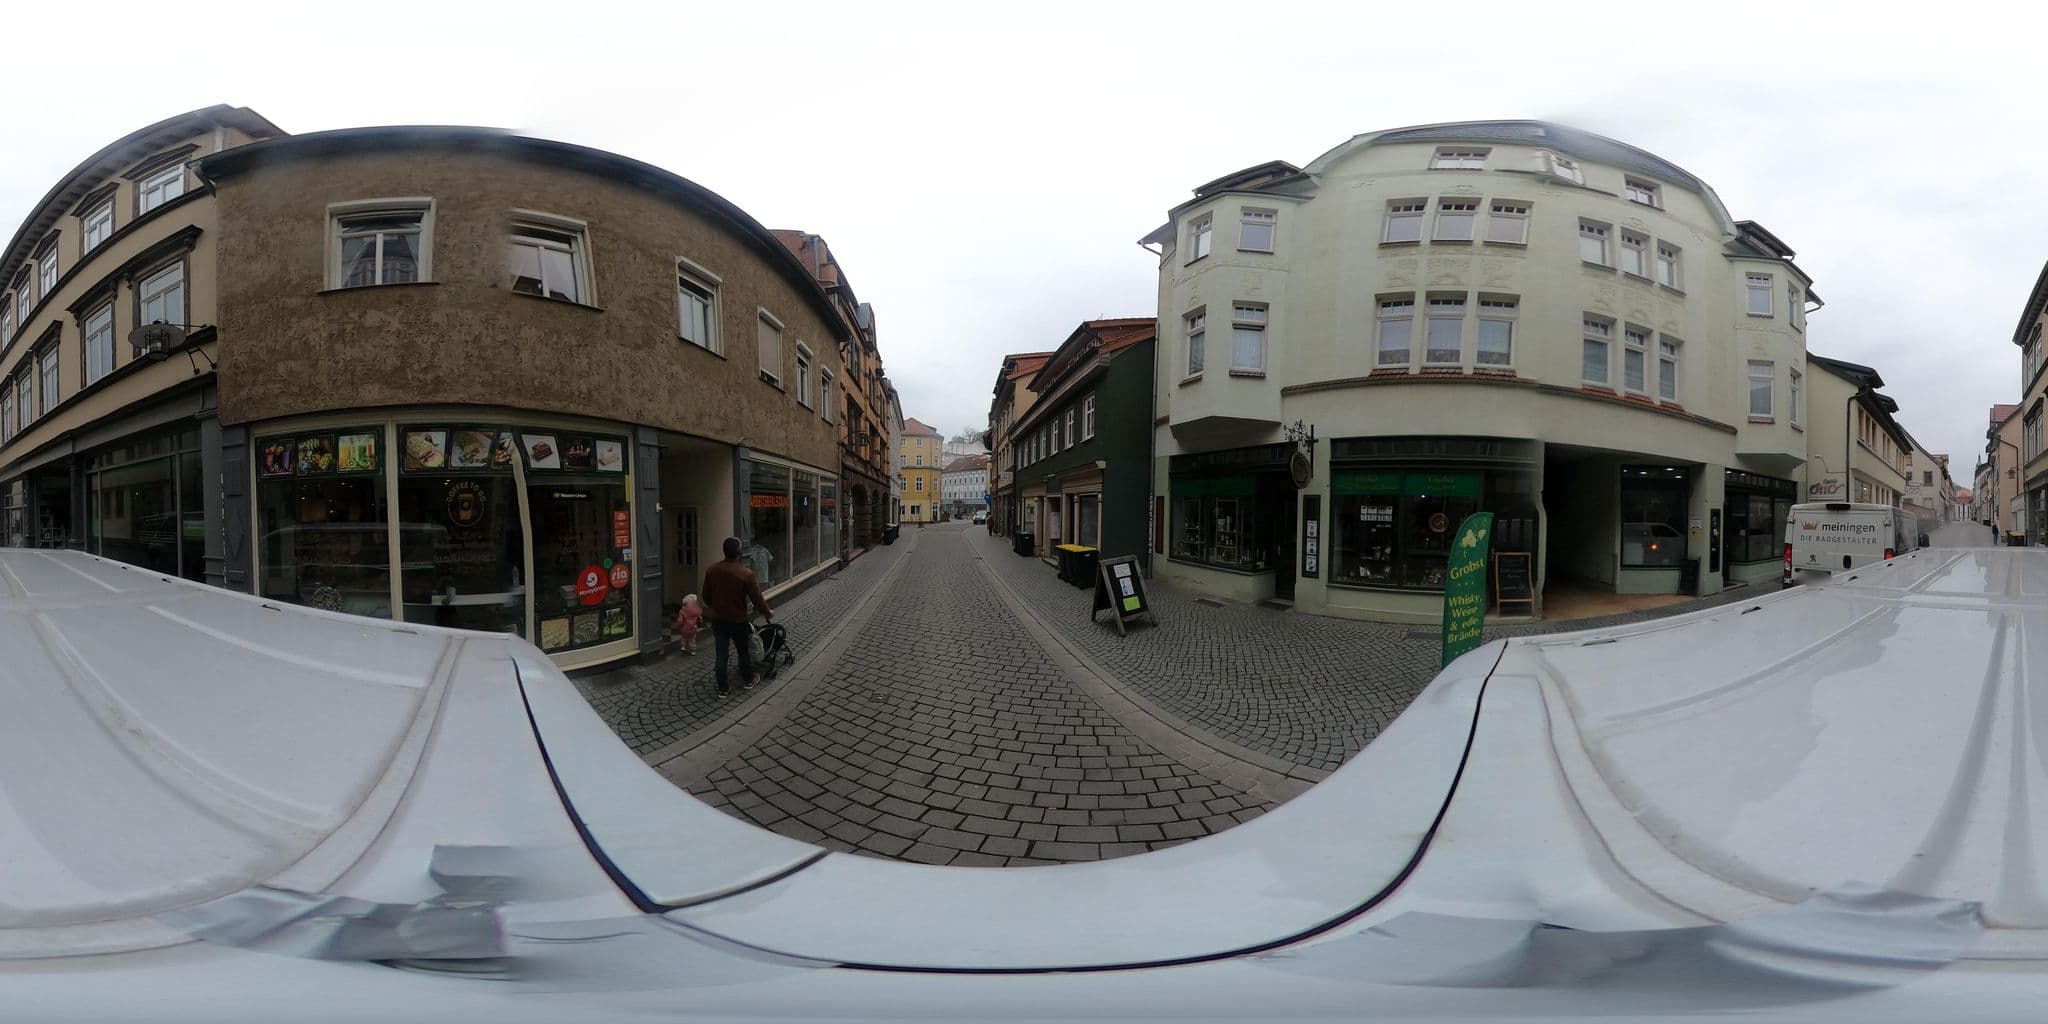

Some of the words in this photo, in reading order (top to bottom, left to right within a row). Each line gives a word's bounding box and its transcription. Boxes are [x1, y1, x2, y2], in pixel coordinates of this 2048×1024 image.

[446, 481, 469, 503] COFFEE
[470, 481, 480, 491] TO
[478, 489, 487, 502] GO
[1822, 522, 1875, 534] meiningen
[1800, 534, 1814, 542] DIE
[1815, 535, 1877, 544] BADGESTALTER
[612, 568, 627, 581] ria
[1450, 557, 1485, 580] Grobst
[579, 585, 607, 596] MoneyGram
[1448, 593, 1483, 607] Whisky,
[1452, 606, 1479, 618] Weine
[1450, 621, 1458, 631] &
[1448, 627, 1481, 643] Brände
